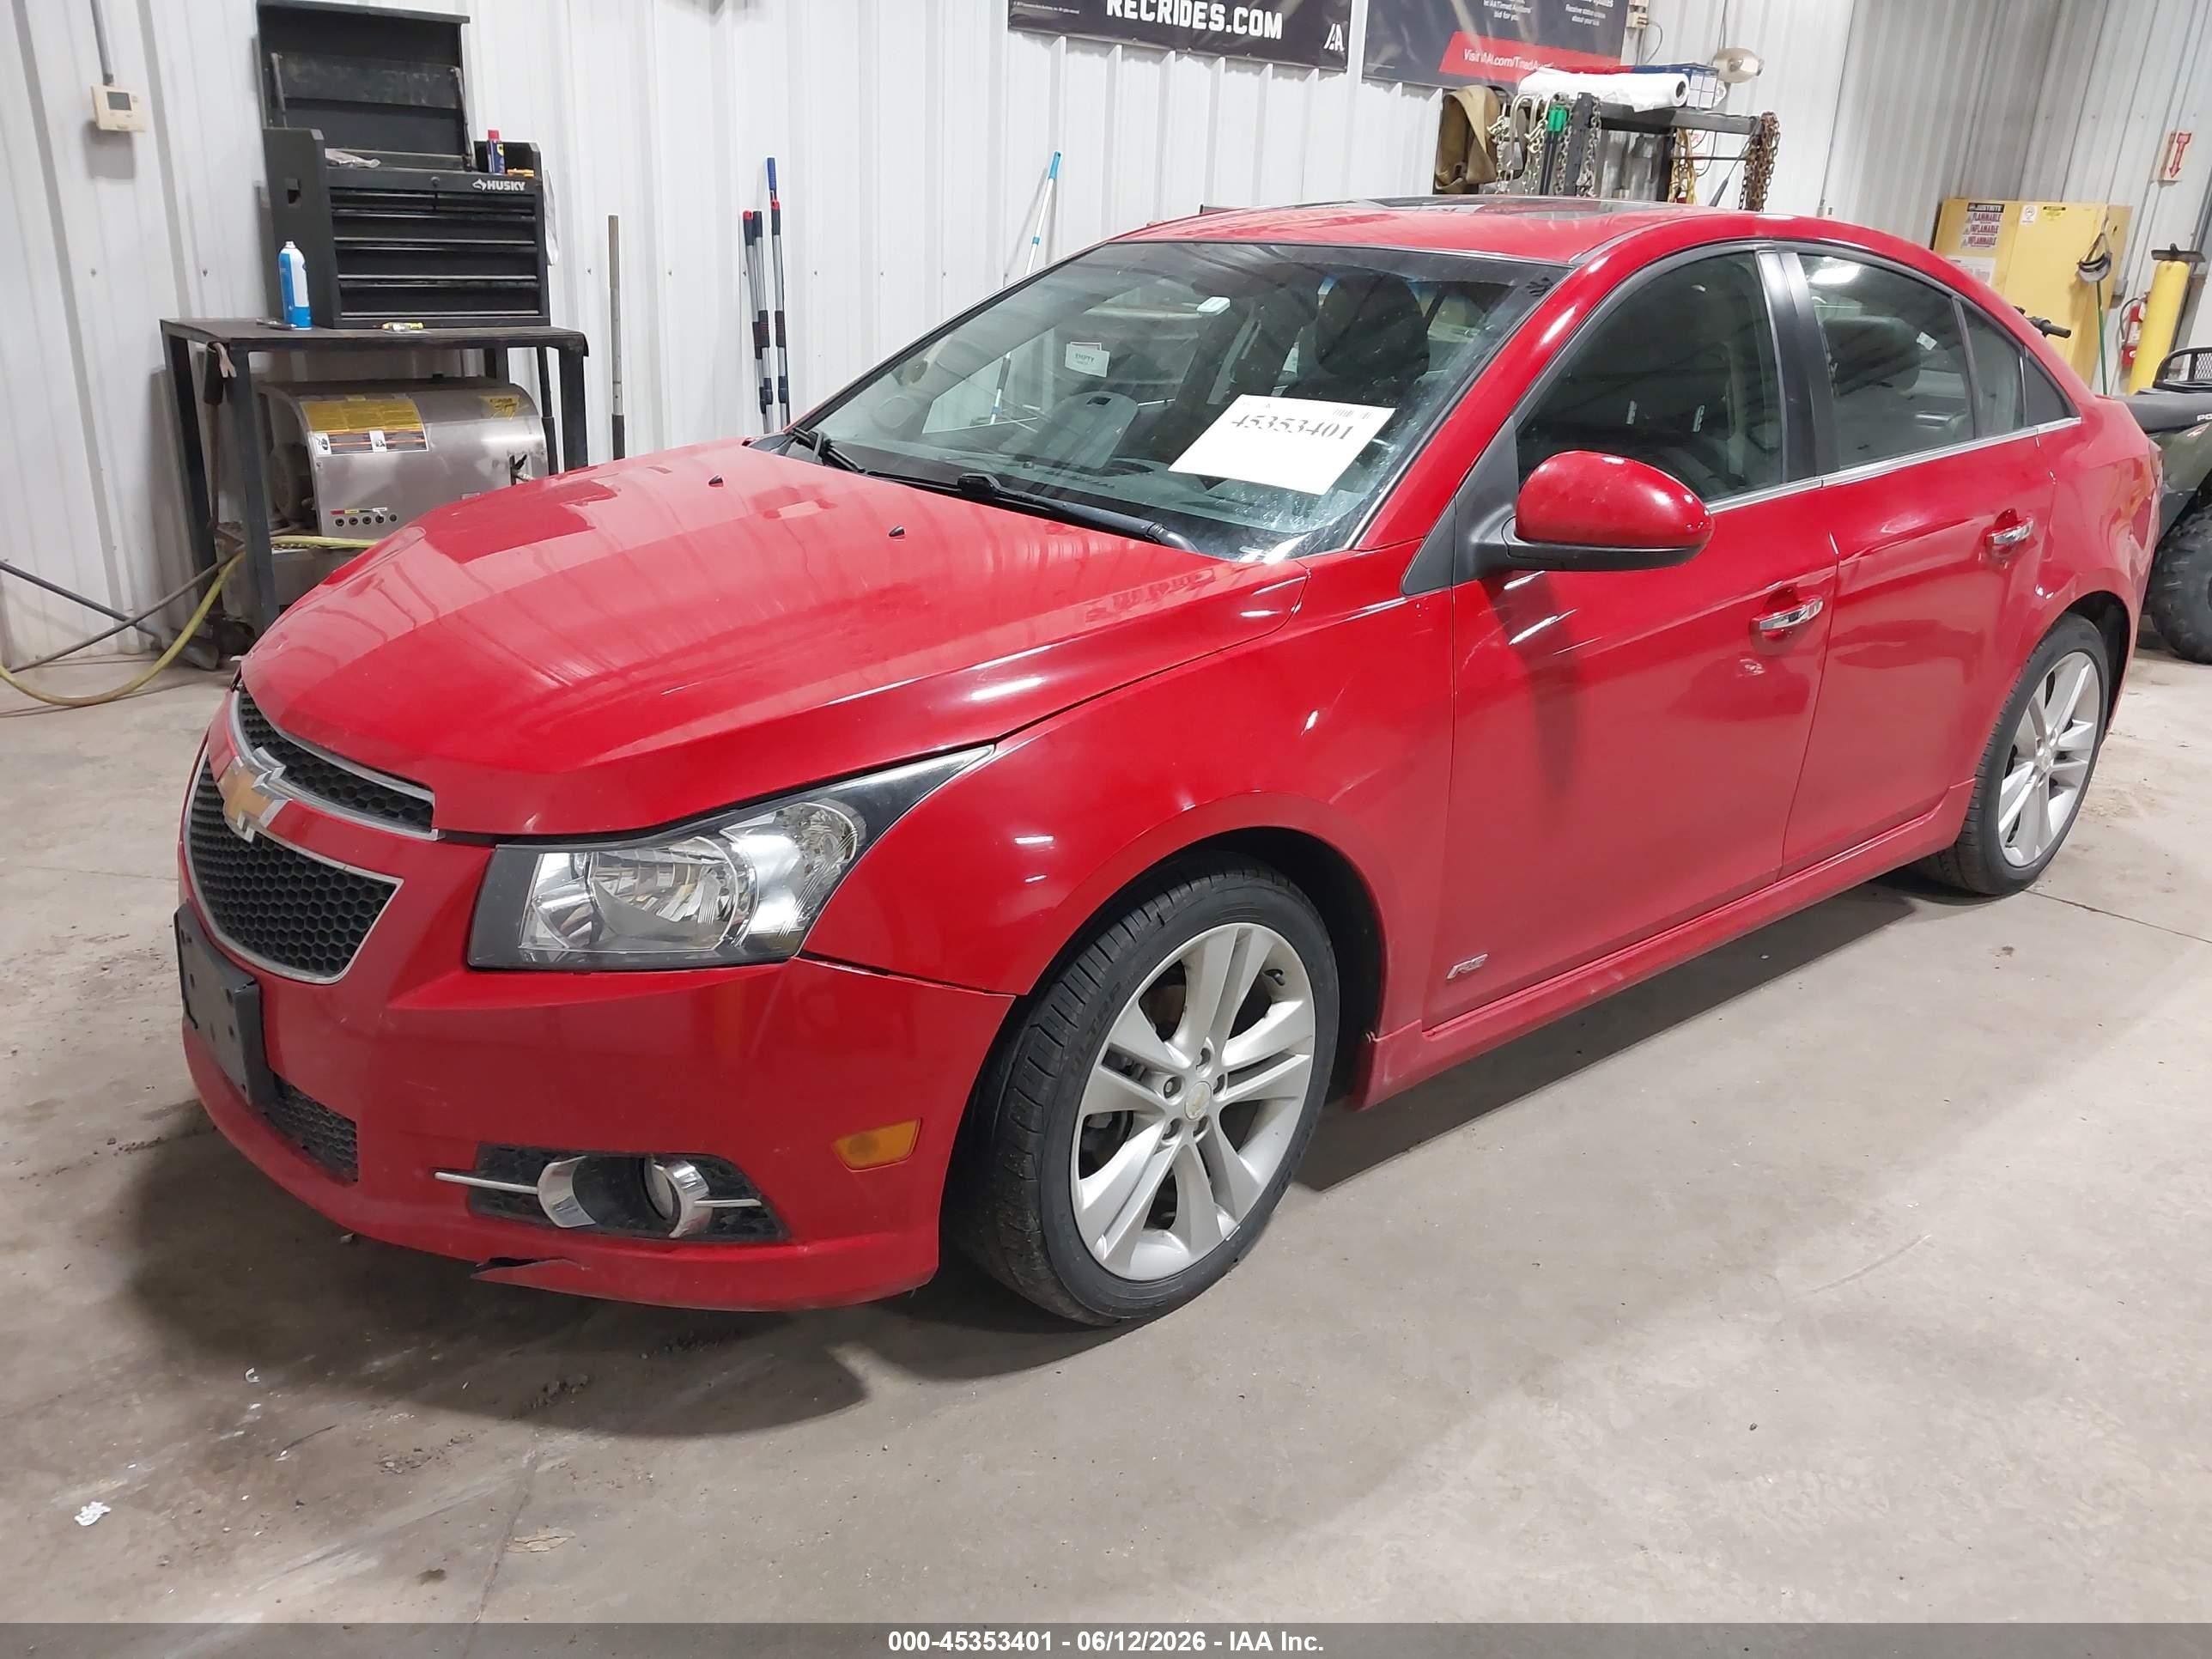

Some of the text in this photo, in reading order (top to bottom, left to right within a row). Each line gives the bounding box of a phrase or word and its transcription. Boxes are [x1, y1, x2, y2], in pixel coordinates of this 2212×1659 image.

[1106, 0, 1283, 40] RECRIDES.COM
[1463, 48, 1480, 63] Visit
[487, 179, 526, 191] HUSKY
[1231, 414, 1354, 440] 45353401
